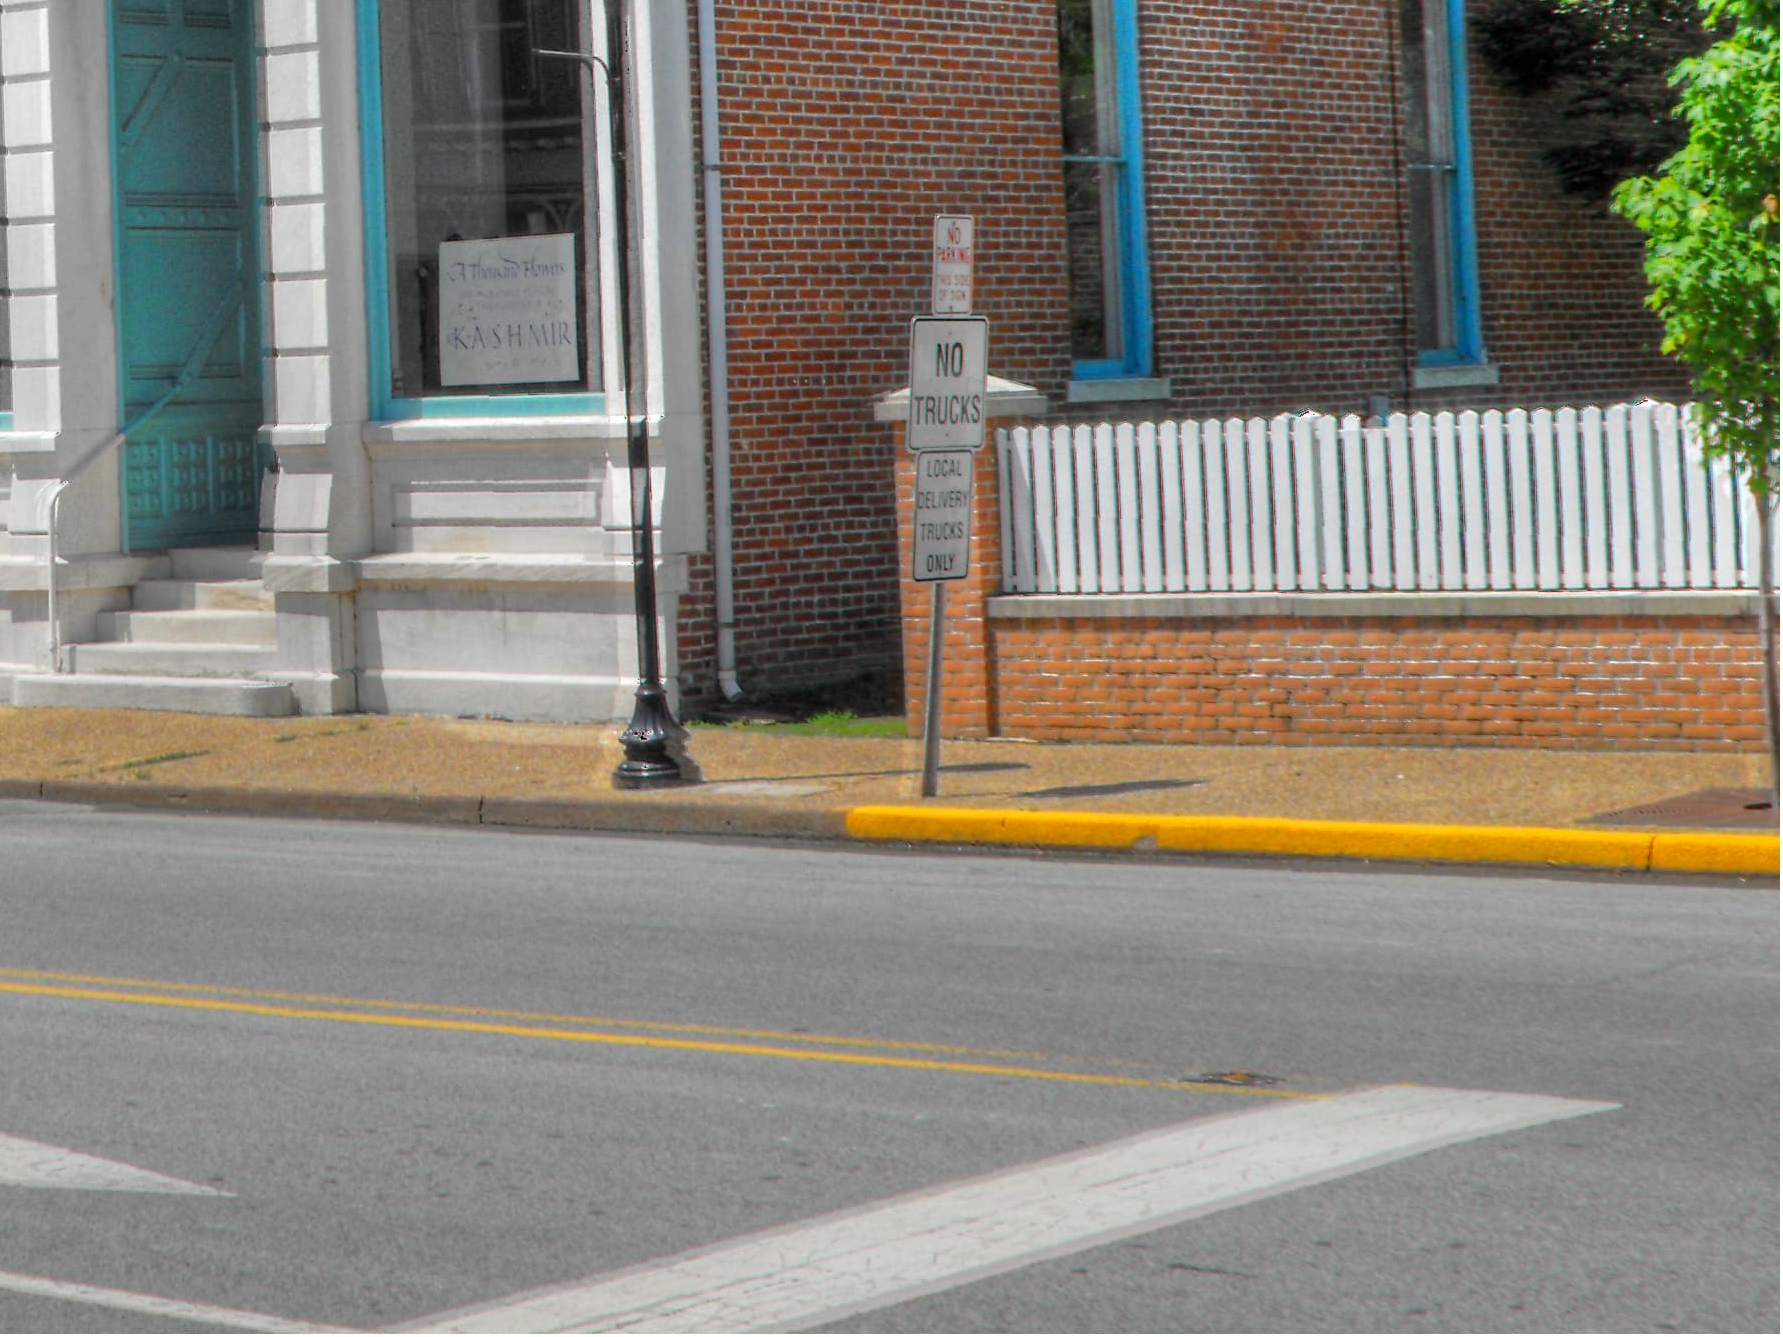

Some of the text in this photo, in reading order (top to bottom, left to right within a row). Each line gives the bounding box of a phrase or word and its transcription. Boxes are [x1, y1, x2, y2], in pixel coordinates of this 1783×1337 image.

[948, 226, 961, 245] NO
[936, 246, 971, 263] PARKING
[448, 321, 572, 350] KASHMIR
[935, 341, 964, 378] NO
[913, 394, 981, 425] TRUCKS
[926, 459, 963, 478] LOCAL
[917, 489, 968, 510] DELIVERY
[920, 521, 965, 541] TRUCKS
[926, 553, 955, 573] ONLY
